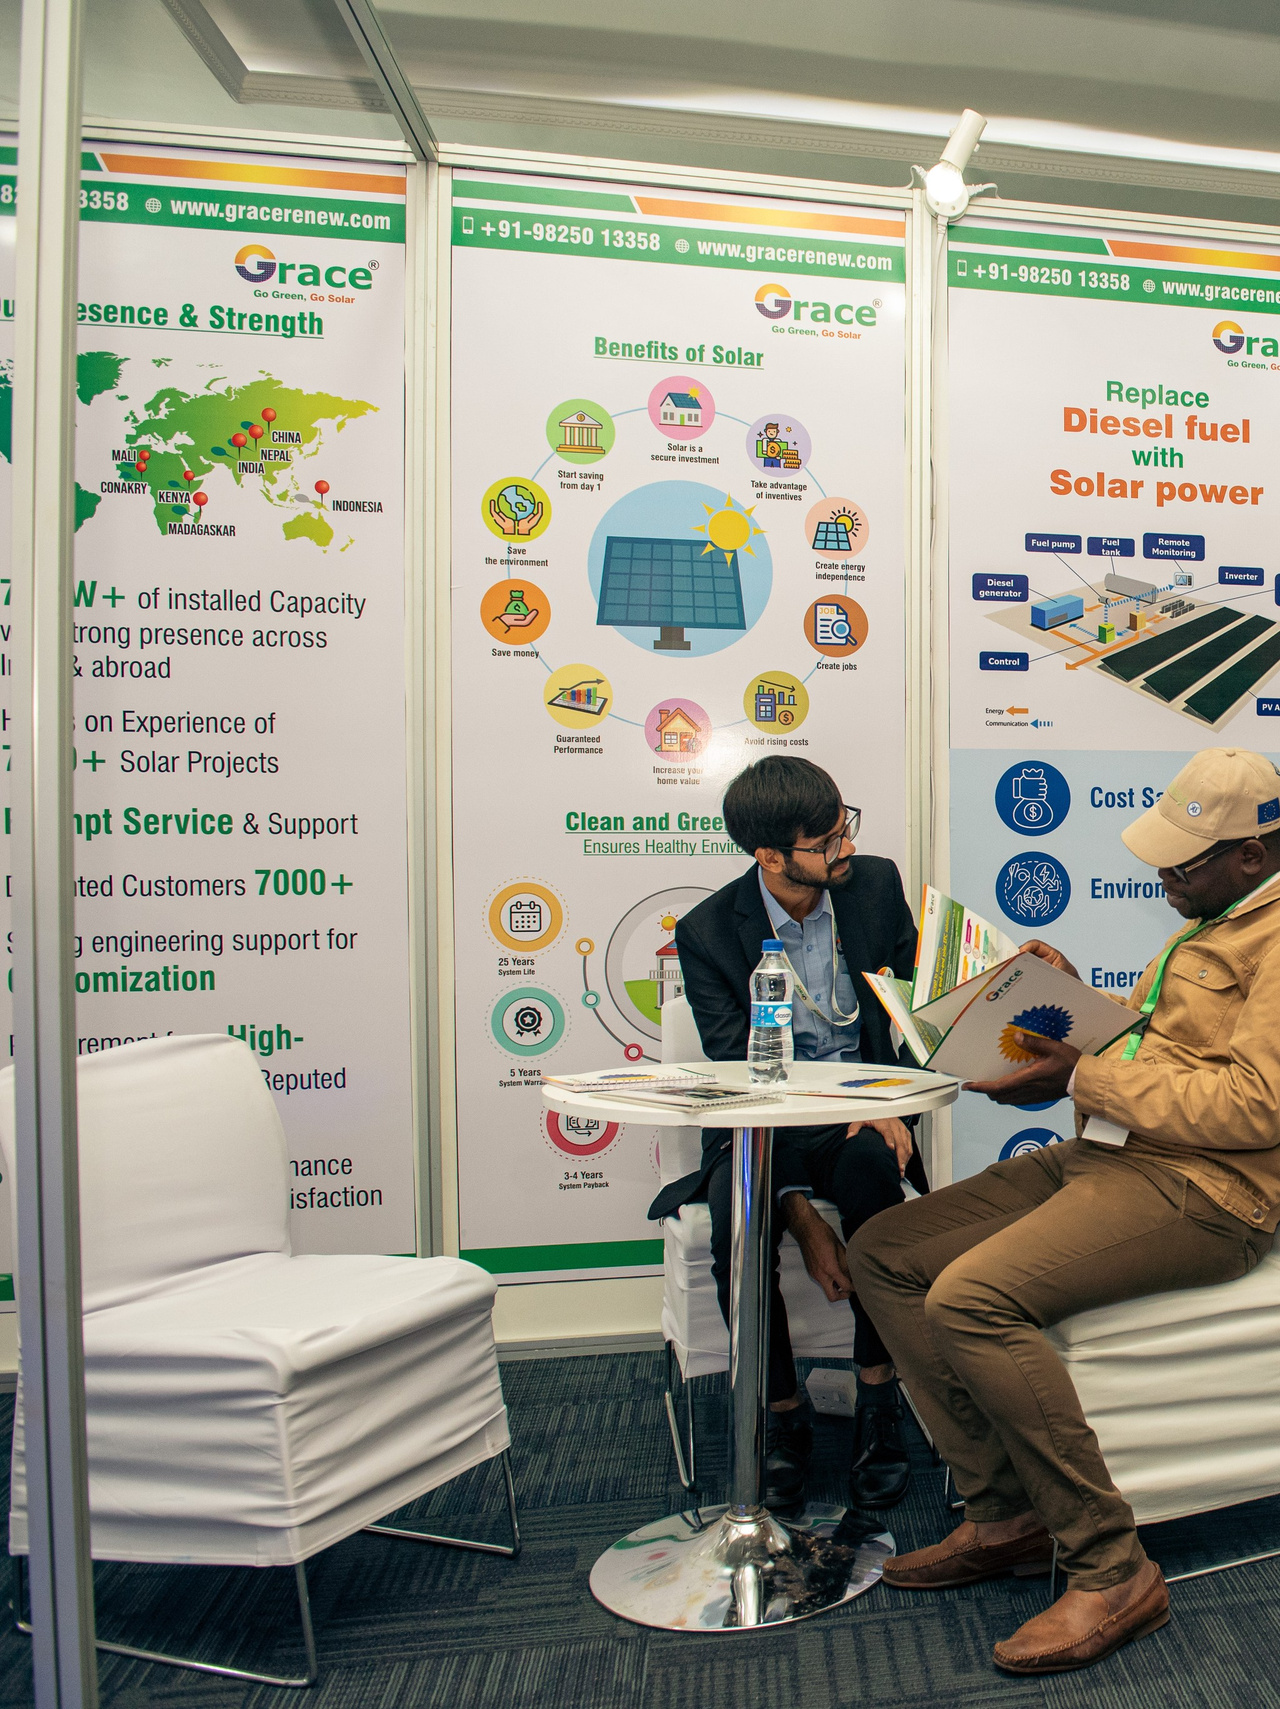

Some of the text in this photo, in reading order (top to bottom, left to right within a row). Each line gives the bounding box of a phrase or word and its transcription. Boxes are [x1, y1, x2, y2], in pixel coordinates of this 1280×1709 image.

[171, 200, 391, 230] www.gracerenew.com
[480, 221, 892, 270] +91-98250 13358 www.gracerenew.com
[974, 263, 1072, 286] +91-98250
[1079, 270, 1130, 291] 13358
[254, 289, 355, 304] Go Green, Go Solar
[179, 304, 324, 338] & Strength
[594, 336, 764, 366] Benefits of Solar
[1227, 359, 1239, 368] Go
[1241, 361, 1268, 371] Green,
[1106, 381, 1209, 409] Replace
[1063, 407, 1250, 443] Diesel fuel
[272, 431, 301, 443] CHINA
[667, 442, 688, 453] Solar
[112, 450, 136, 461] MALI
[261, 449, 291, 462] NEPAL
[651, 454, 719, 465] secure investment
[1131, 447, 1184, 468] with
[238, 462, 264, 474] INDIA
[558, 470, 604, 481] Start saving
[100, 481, 147, 494] CONAKRY
[560, 481, 594, 492] from day
[751, 480, 807, 492] Take advantage
[1050, 470, 1263, 507] Solar power
[158, 491, 190, 503] KENYA
[766, 491, 802, 501] inventives
[332, 500, 383, 513] INDONESIA
[168, 523, 235, 536] MADAGASKAR
[1032, 539, 1075, 550] Fuel pump
[1102, 538, 1119, 547] Fuel
[1158, 538, 1190, 548] Remote
[507, 546, 526, 556] Save
[1102, 548, 1120, 556] tank
[1152, 548, 1196, 557] Monitoring
[498, 557, 548, 567] environment
[815, 561, 866, 573] Create energy
[815, 571, 866, 582] independence
[1225, 572, 1258, 581] Inverter
[987, 579, 1014, 587] Diesel
[979, 589, 1021, 598] generator
[138, 588, 160, 610] of
[168, 590, 261, 612] installed
[270, 591, 366, 619] Capacity
[819, 607, 835, 615] JOB
[140, 626, 327, 650] presence across
[492, 648, 539, 659] Save money
[92, 656, 171, 679] abroad
[816, 661, 857, 672] Create jobs
[988, 657, 1020, 666] Control
[986, 708, 1004, 716] Energy
[1262, 703, 1273, 712] PV
[85, 711, 276, 737] on Experience of
[556, 733, 600, 744] Guaranteed
[767, 737, 808, 747] rising costs
[554, 745, 603, 754] Performance
[121, 750, 180, 773] Solar
[188, 751, 279, 777] Projects
[1091, 787, 1135, 808] Cost
[123, 808, 233, 835] Service
[243, 814, 259, 835] &
[269, 813, 358, 839] Support
[566, 812, 727, 831] Clean and Gree
[584, 838, 696, 858] Ensures Healthy
[122, 874, 246, 897] Customers
[255, 869, 353, 895] 7000+
[92, 931, 223, 958] engineering
[232, 929, 320, 956] support
[327, 928, 358, 949] for
[498, 957, 535, 967] 25 Years
[228, 1024, 303, 1056] High-
[518, 1068, 541, 1078] Years
[262, 1068, 346, 1095] Reputed
[499, 1079, 521, 1087] System
[564, 1170, 603, 1180] 3-4 Years
[559, 1181, 609, 1191] System Payback
